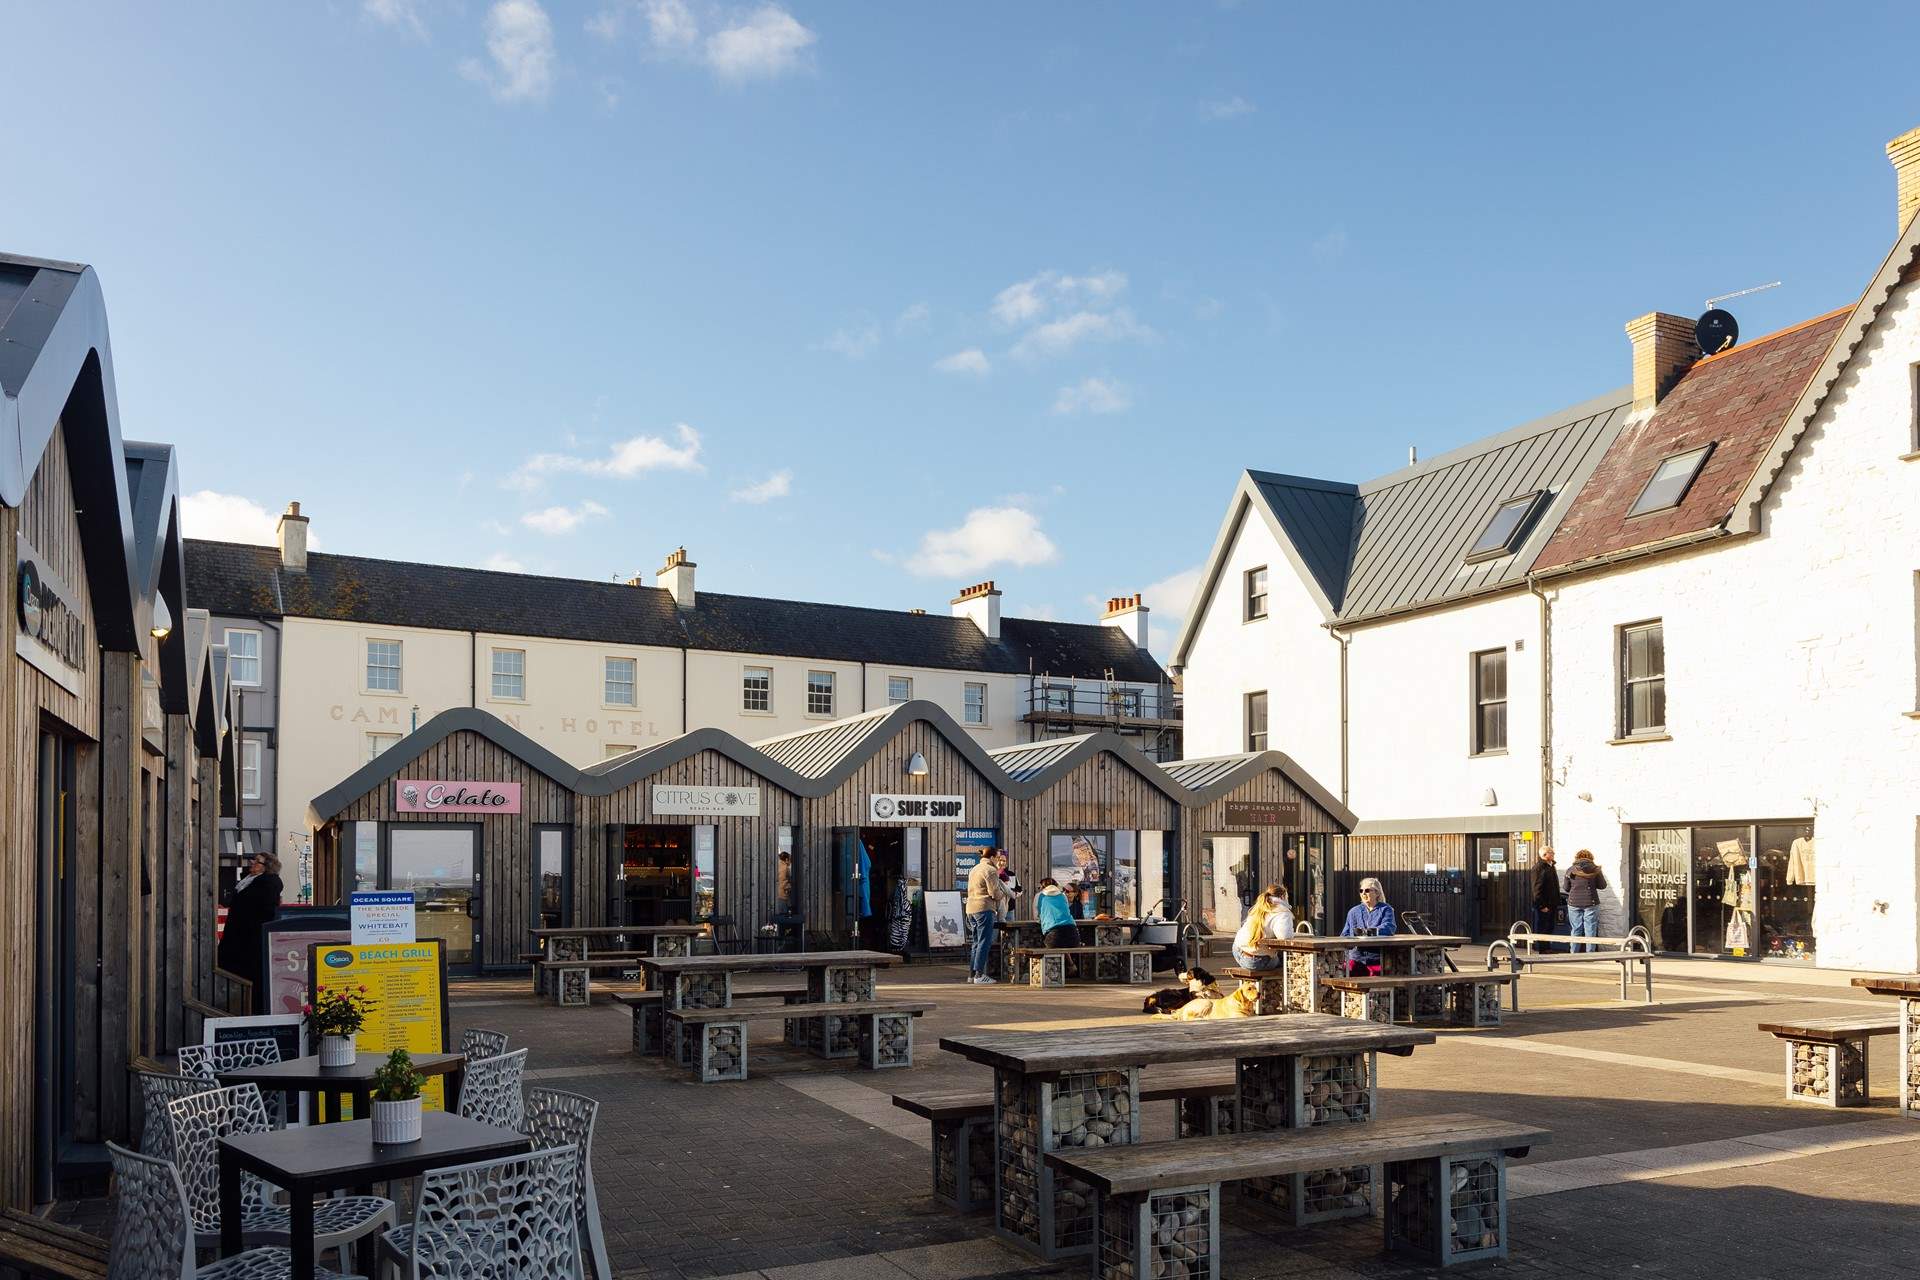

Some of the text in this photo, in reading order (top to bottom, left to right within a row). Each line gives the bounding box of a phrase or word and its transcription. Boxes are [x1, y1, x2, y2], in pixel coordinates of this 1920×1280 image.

[560, 717, 659, 738] HOTEL
[426, 784, 508, 809] Gelato
[656, 790, 758, 806] CITRUS COVE
[898, 800, 962, 817] SURF SHOP
[956, 830, 993, 839] Surf Lessons
[1640, 843, 1688, 855] WELCOME
[1640, 858, 1661, 869] AND
[1639, 873, 1687, 885] HERITAGE
[1639, 889, 1677, 900] CENTRE
[358, 922, 409, 930] WHITEBAIT
[359, 948, 433, 961] BEACH GRILL
